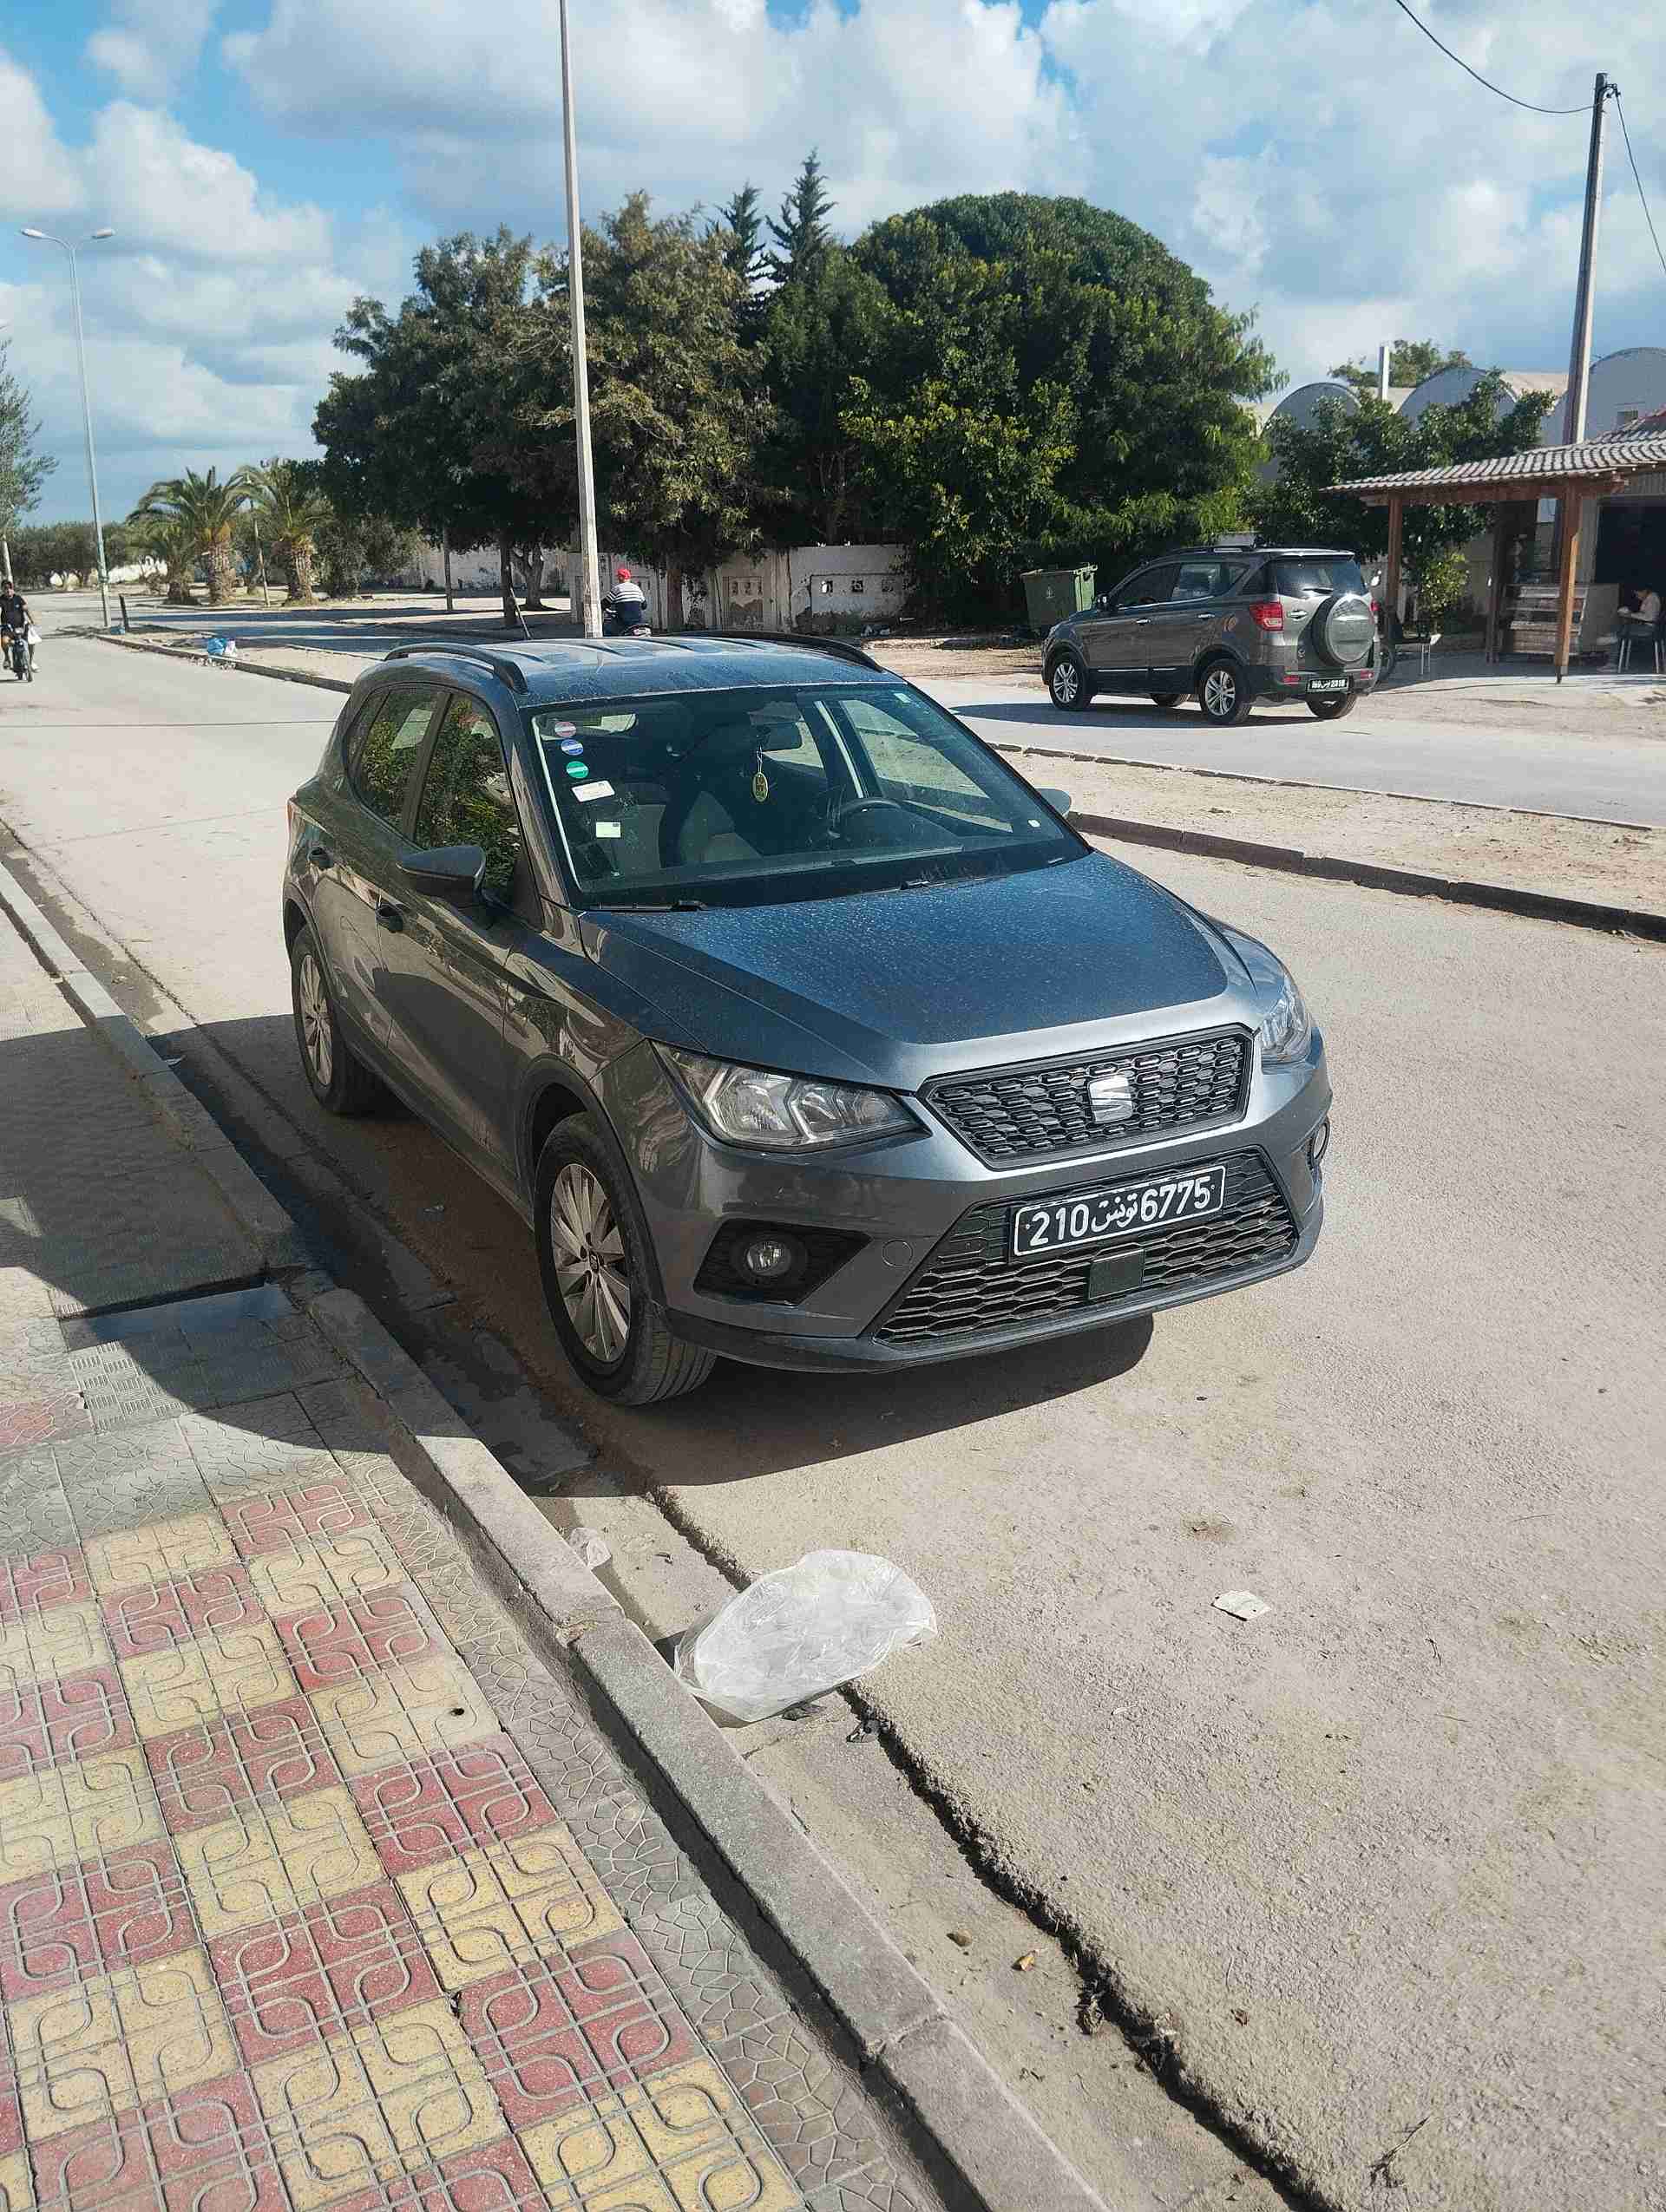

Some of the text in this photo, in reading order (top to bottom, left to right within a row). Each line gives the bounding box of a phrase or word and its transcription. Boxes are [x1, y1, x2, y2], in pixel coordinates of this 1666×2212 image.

[1029, 1175, 1211, 1247] 210 تونس 6775
